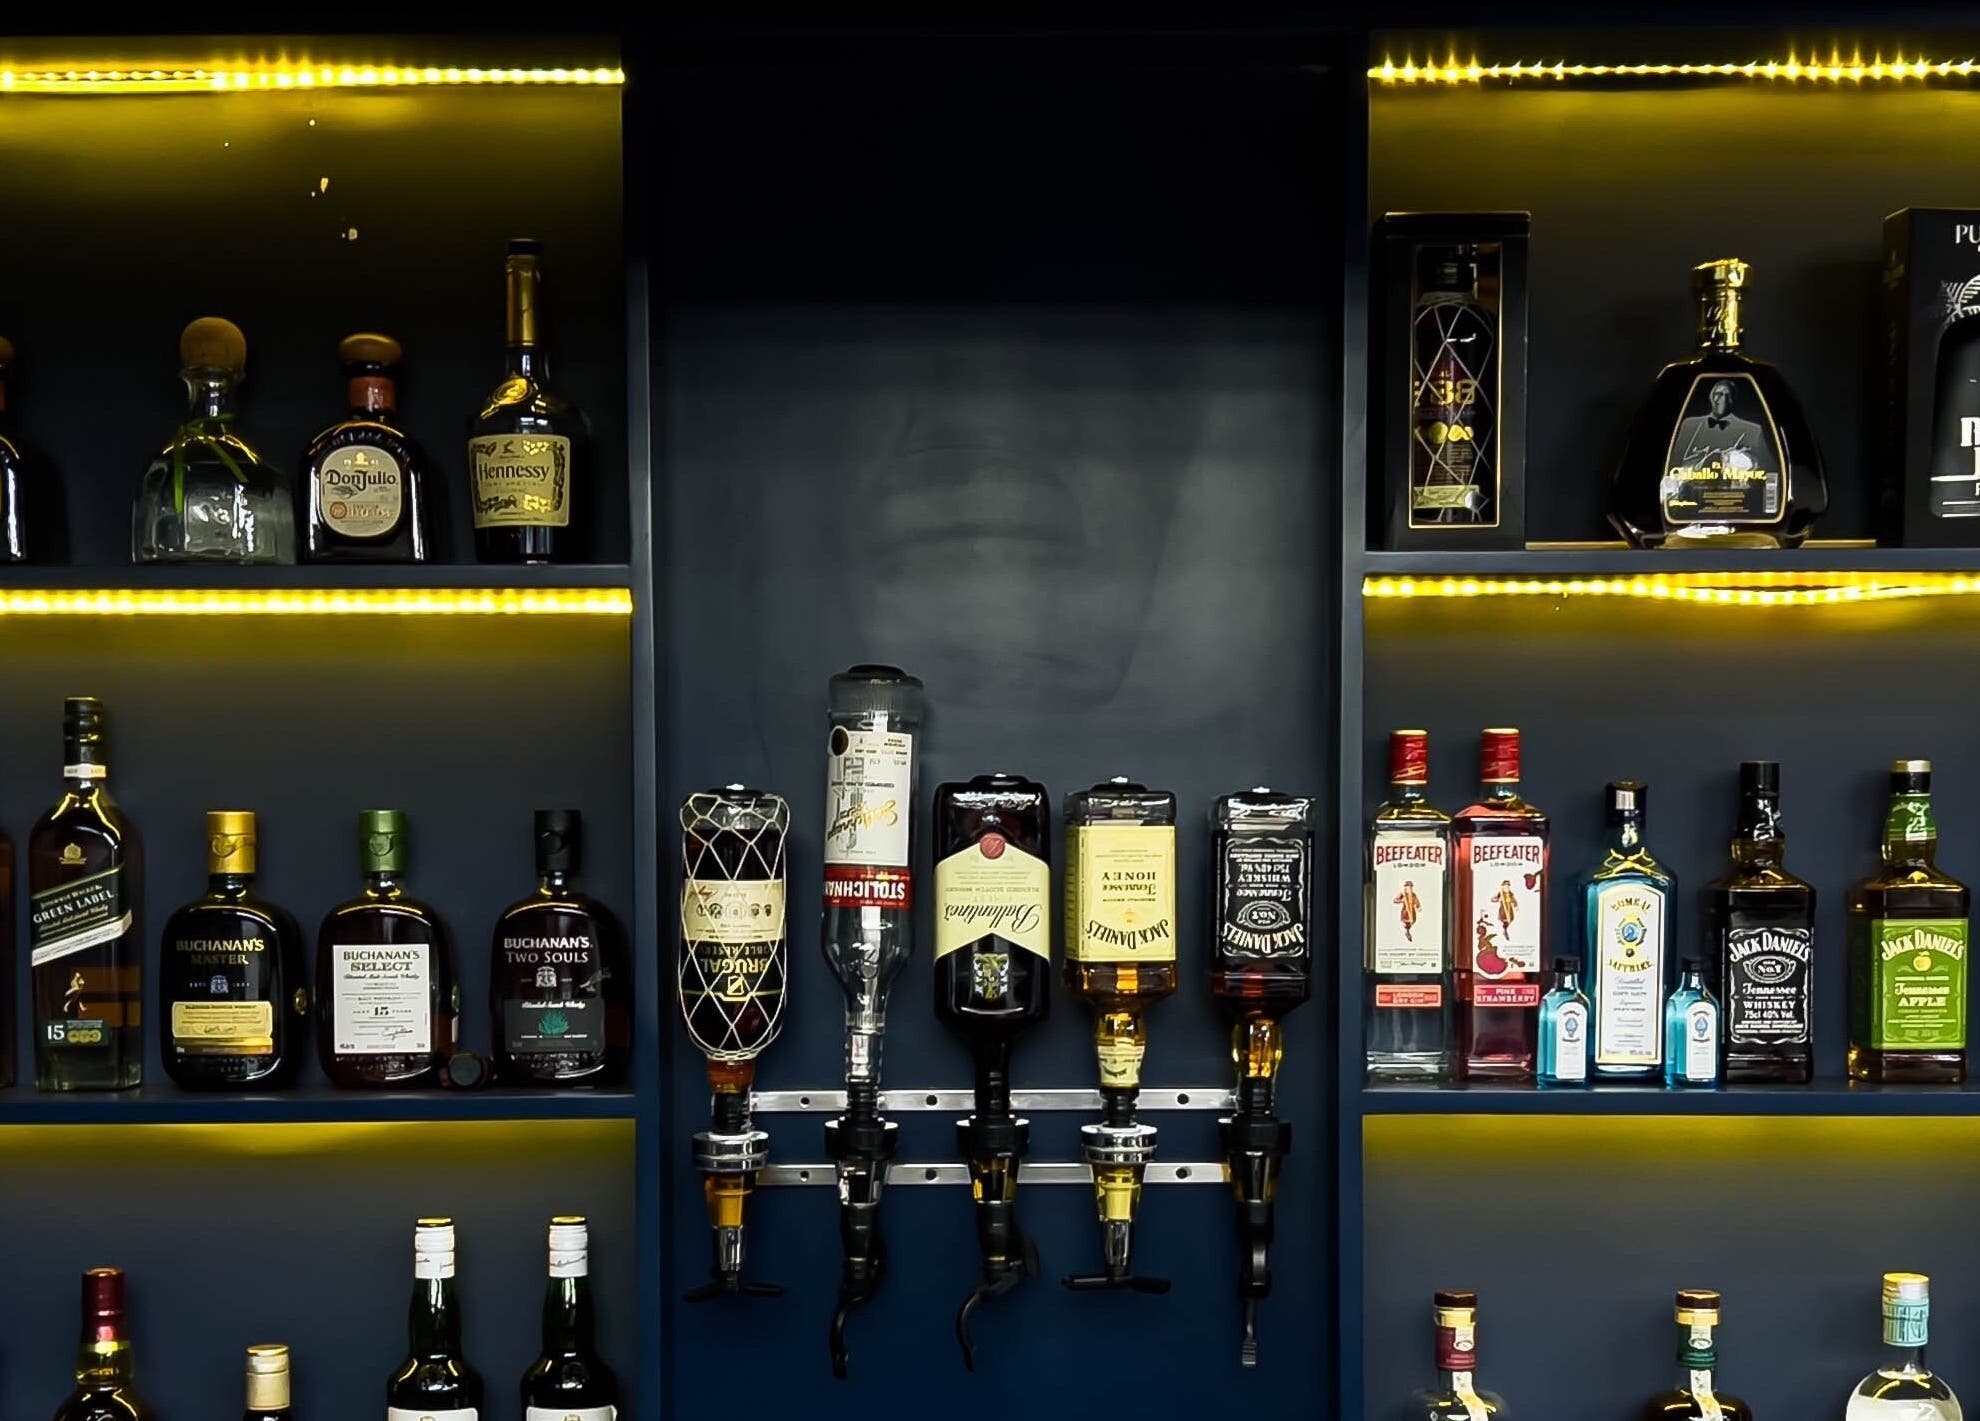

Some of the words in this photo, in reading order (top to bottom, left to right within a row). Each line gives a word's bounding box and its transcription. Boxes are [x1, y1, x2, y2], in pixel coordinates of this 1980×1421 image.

[479, 463, 550, 481] Hennessy
[1376, 845, 1442, 865] BEEFEATER
[1473, 845, 1540, 864] BEEFEATER
[1102, 872, 1156, 881] HONEY
[1237, 874, 1291, 883] WHISKEY
[1236, 888, 1291, 901] Tennessee
[32, 902, 74, 923] GREEN
[75, 889, 114, 909] LABEL
[944, 904, 1042, 934] Ballantine's
[1085, 919, 1136, 950] DANIEL'S
[1138, 919, 1169, 945] JACK
[1221, 922, 1271, 954] DANIEL'S
[1272, 923, 1304, 949] JACK
[176, 937, 265, 952] BUCHANAN'S
[504, 936, 589, 948] BUCHANAN'S
[1728, 937, 1762, 962] JACK
[1762, 932, 1811, 962] DANIEL'S
[1881, 935, 1914, 960] JACK
[1914, 929, 1964, 960] DANIEL'S
[191, 954, 249, 965] MASTER
[343, 950, 420, 961] BUCHANAN'S
[506, 952, 538, 963] TWO
[544, 951, 589, 963] SOULS
[350, 962, 413, 971] SELECT
[700, 957, 768, 973] BRUGAL
[1742, 982, 1797, 995] Tennessee
[1742, 1000, 1796, 1009] WHISKEY
[1898, 997, 1946, 1007] APPLE
[374, 1006, 389, 1016] 15
[47, 1024, 65, 1041] 15
